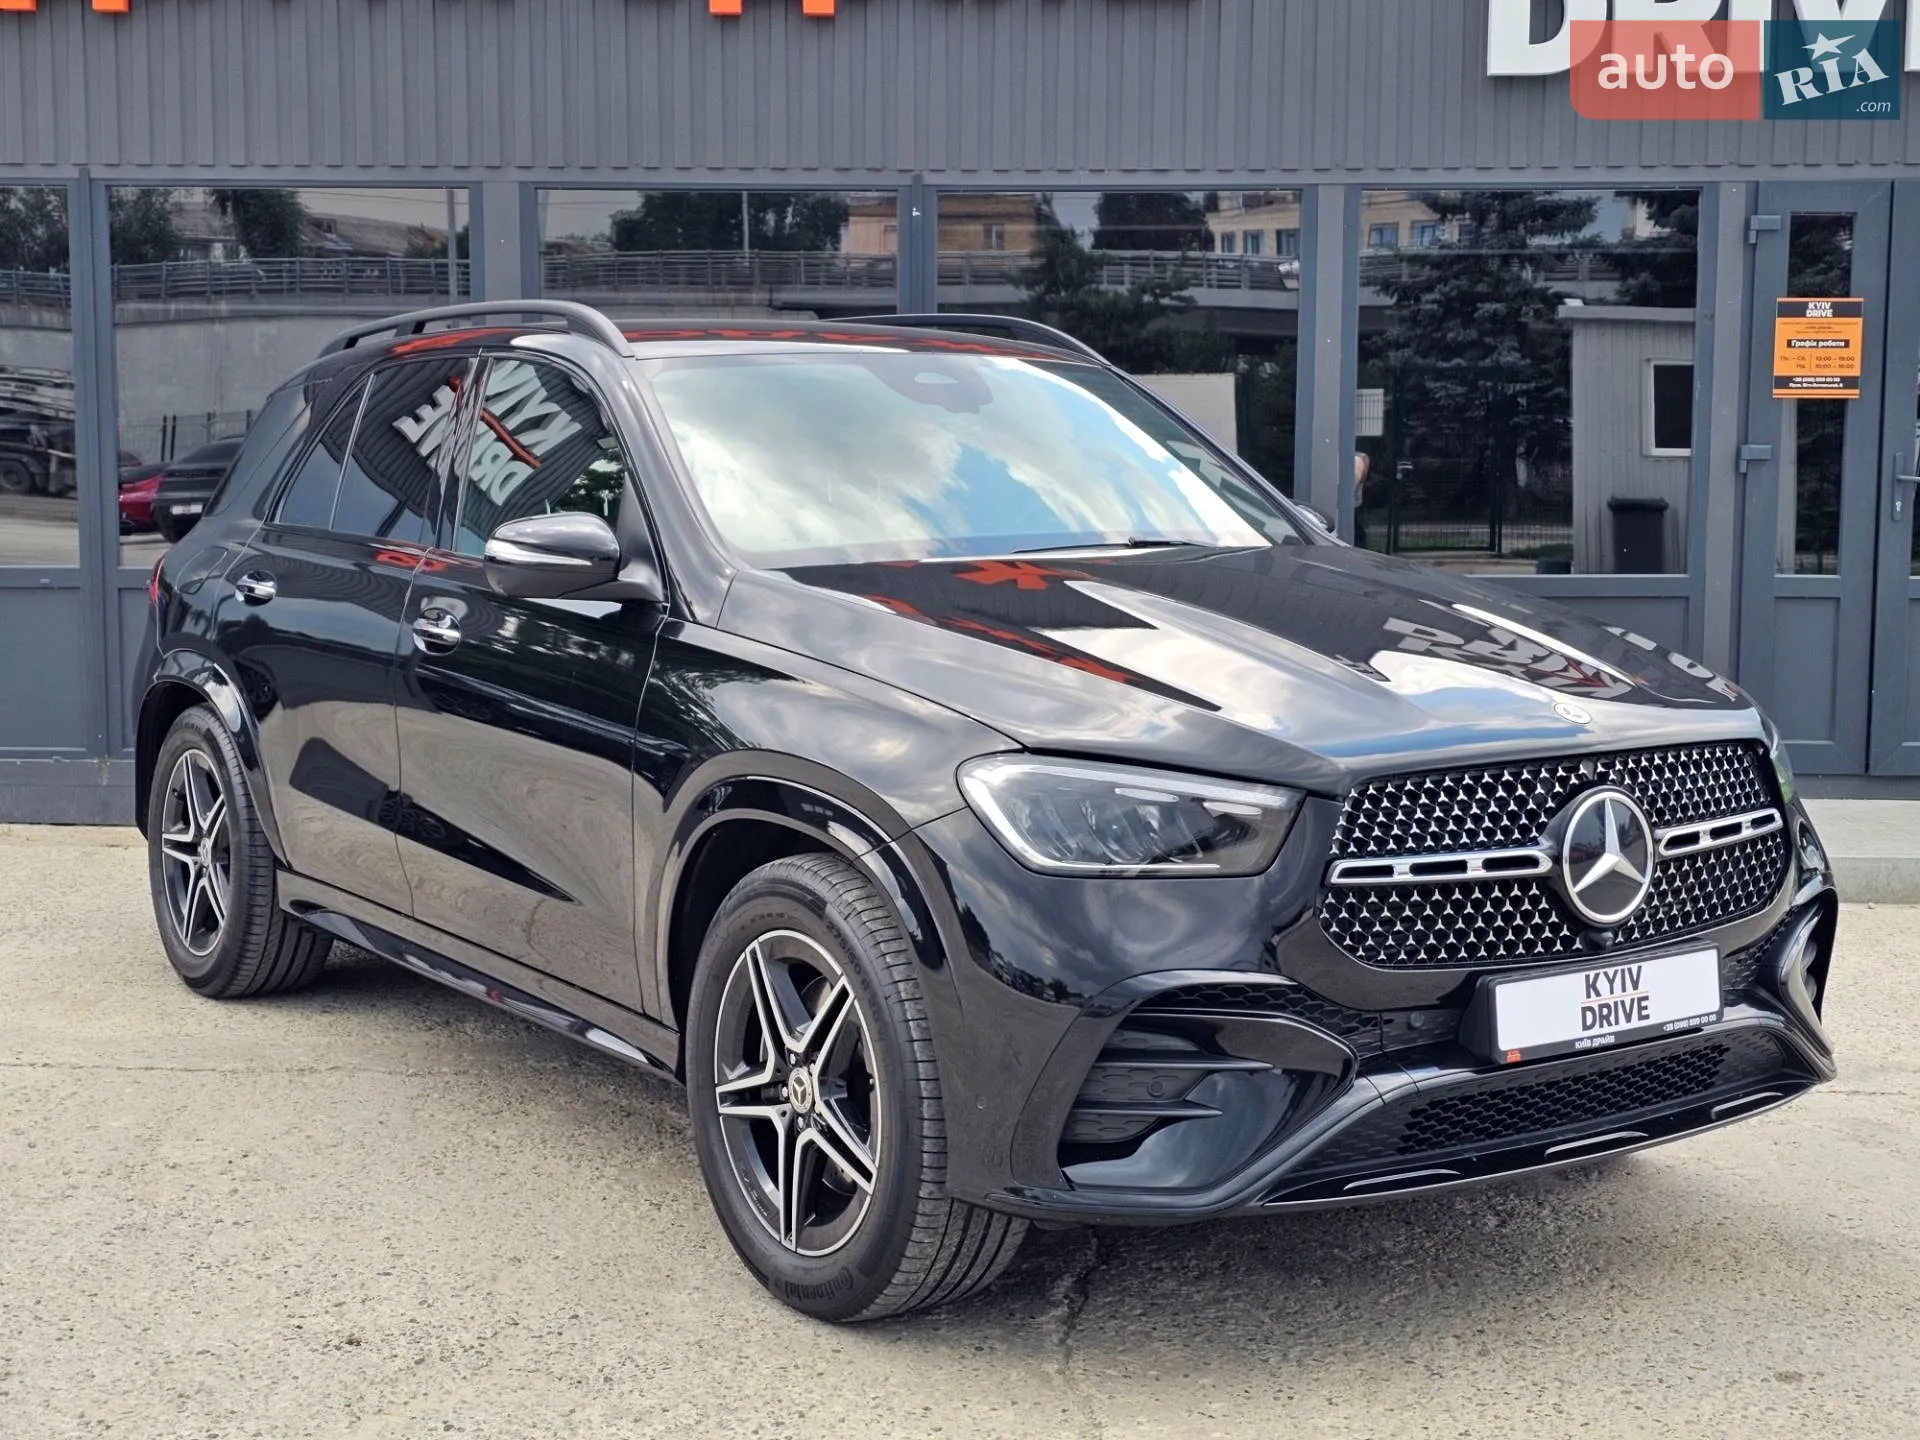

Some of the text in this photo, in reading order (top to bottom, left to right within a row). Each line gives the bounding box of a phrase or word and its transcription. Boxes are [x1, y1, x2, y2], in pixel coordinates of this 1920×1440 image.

[1486, 0, 1920, 76] DRIV
[1806, 309, 1833, 317] DRIVE
[1791, 340, 1845, 348] Графік роботи
[1584, 965, 1643, 999] KYIV
[1580, 995, 1651, 1032] DRIVE
[784, 1265, 855, 1302] Continental
